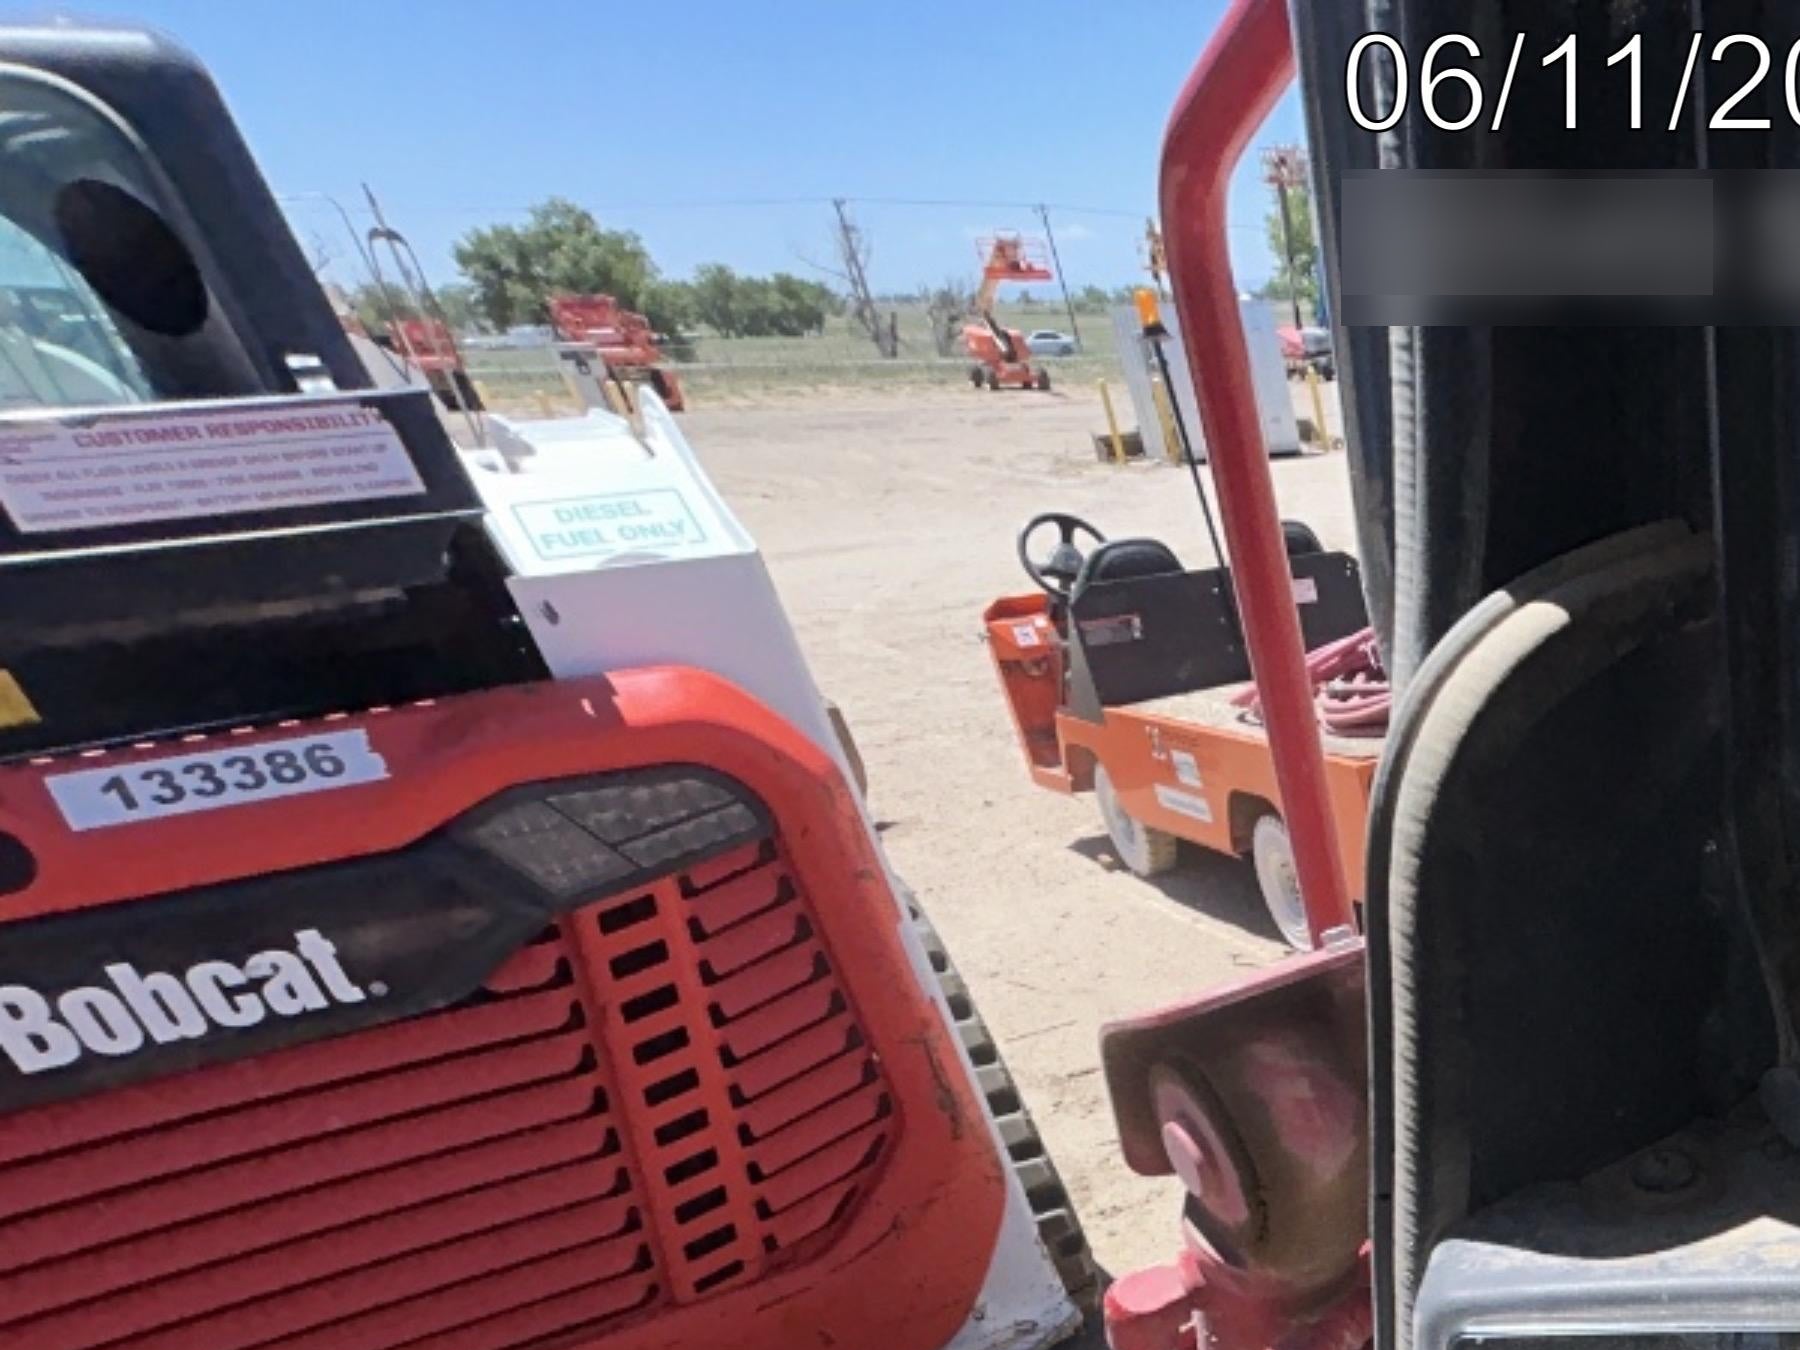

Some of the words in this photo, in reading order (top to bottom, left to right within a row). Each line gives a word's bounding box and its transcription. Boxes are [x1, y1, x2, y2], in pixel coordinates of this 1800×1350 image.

[73, 422, 202, 449] CUSTOMER
[553, 500, 653, 523] DIESEL
[541, 528, 614, 549] FUEL
[617, 519, 685, 541] ONLY
[100, 743, 346, 811] 133386
